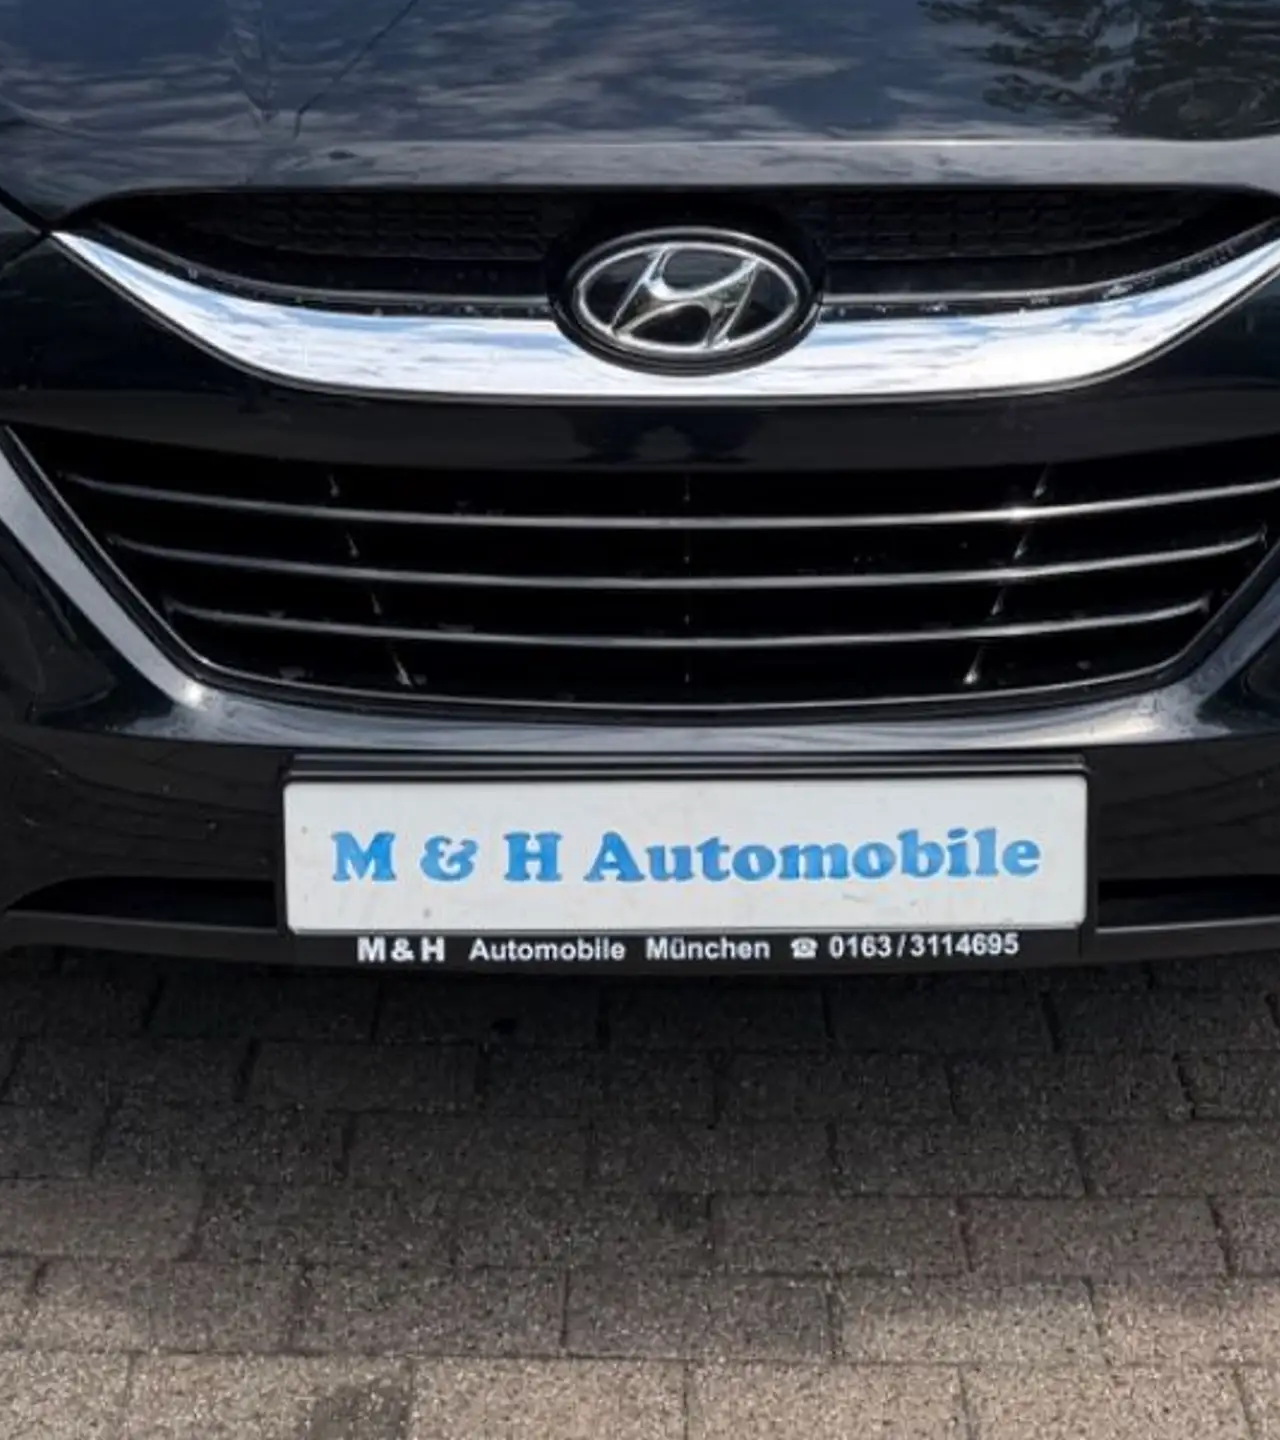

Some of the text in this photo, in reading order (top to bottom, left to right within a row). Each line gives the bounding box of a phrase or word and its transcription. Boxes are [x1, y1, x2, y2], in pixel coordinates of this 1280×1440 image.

[331, 826, 1041, 882] M & H Automobile
[469, 937, 626, 962] Automobile
[646, 935, 770, 961] München
[828, 931, 1020, 958] 0163/3114695
